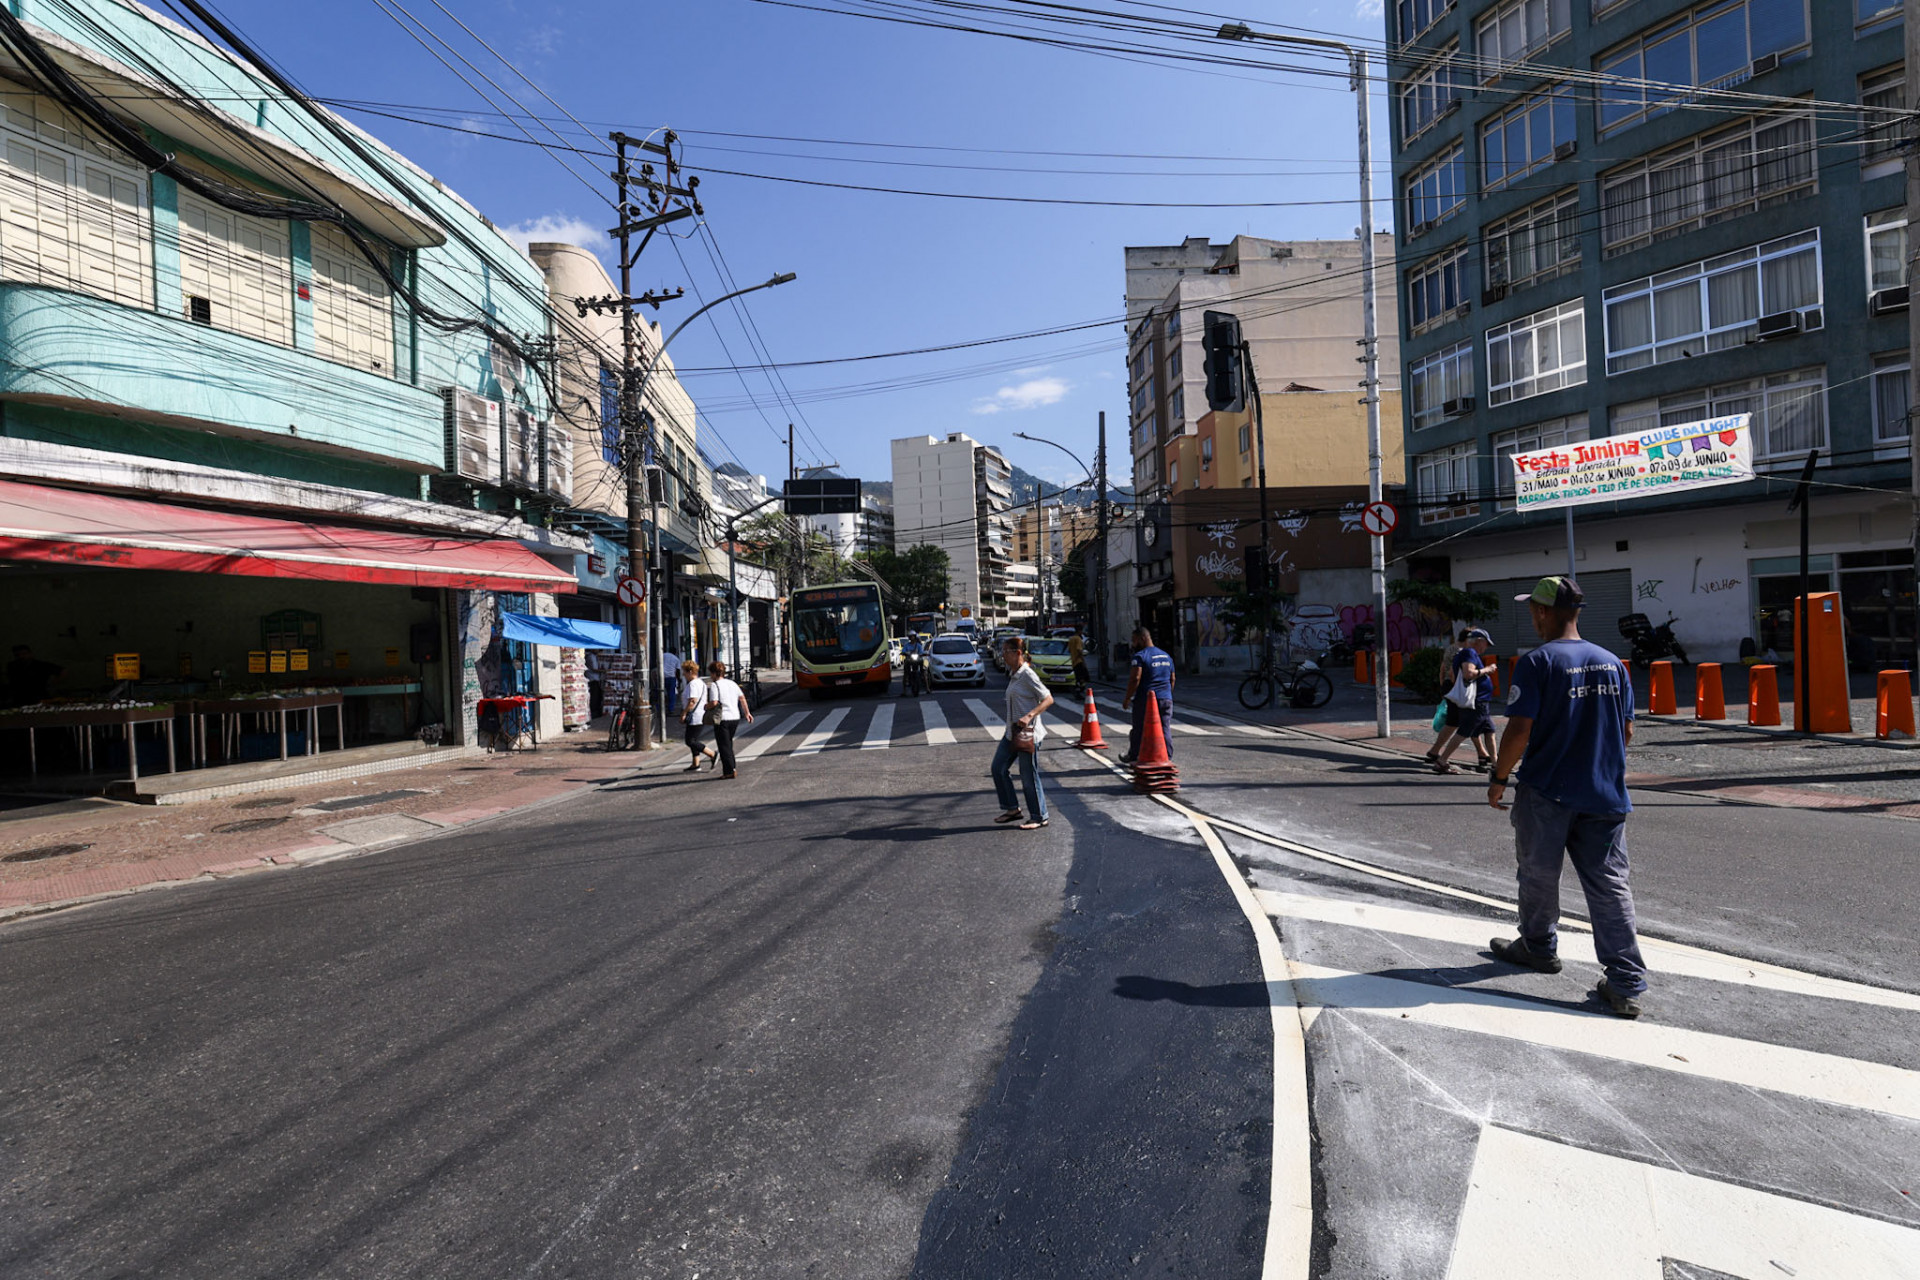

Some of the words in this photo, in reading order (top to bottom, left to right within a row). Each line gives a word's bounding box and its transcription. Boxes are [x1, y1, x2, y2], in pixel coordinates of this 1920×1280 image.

[1640, 428, 1680, 447] CLUBE
[1682, 426, 1700, 437] DA
[1700, 416, 1742, 434] LIGHT
[1516, 451, 1570, 472] Festa
[1573, 440, 1639, 464] Junina
[1518, 491, 1560, 505] BARRACAS
[1631, 480, 1641, 489] DE
[1644, 475, 1673, 487] SERRA
[1708, 465, 1733, 477] KIDS
[1522, 478, 1559, 493] 31/MAIO
[1607, 466, 1636, 481] JUNHO
[1682, 457, 1692, 469] de
[1695, 451, 1727, 467] JUNHO
[1536, 467, 1570, 479] Entrada
[1568, 684, 1620, 699] CET-RIO
